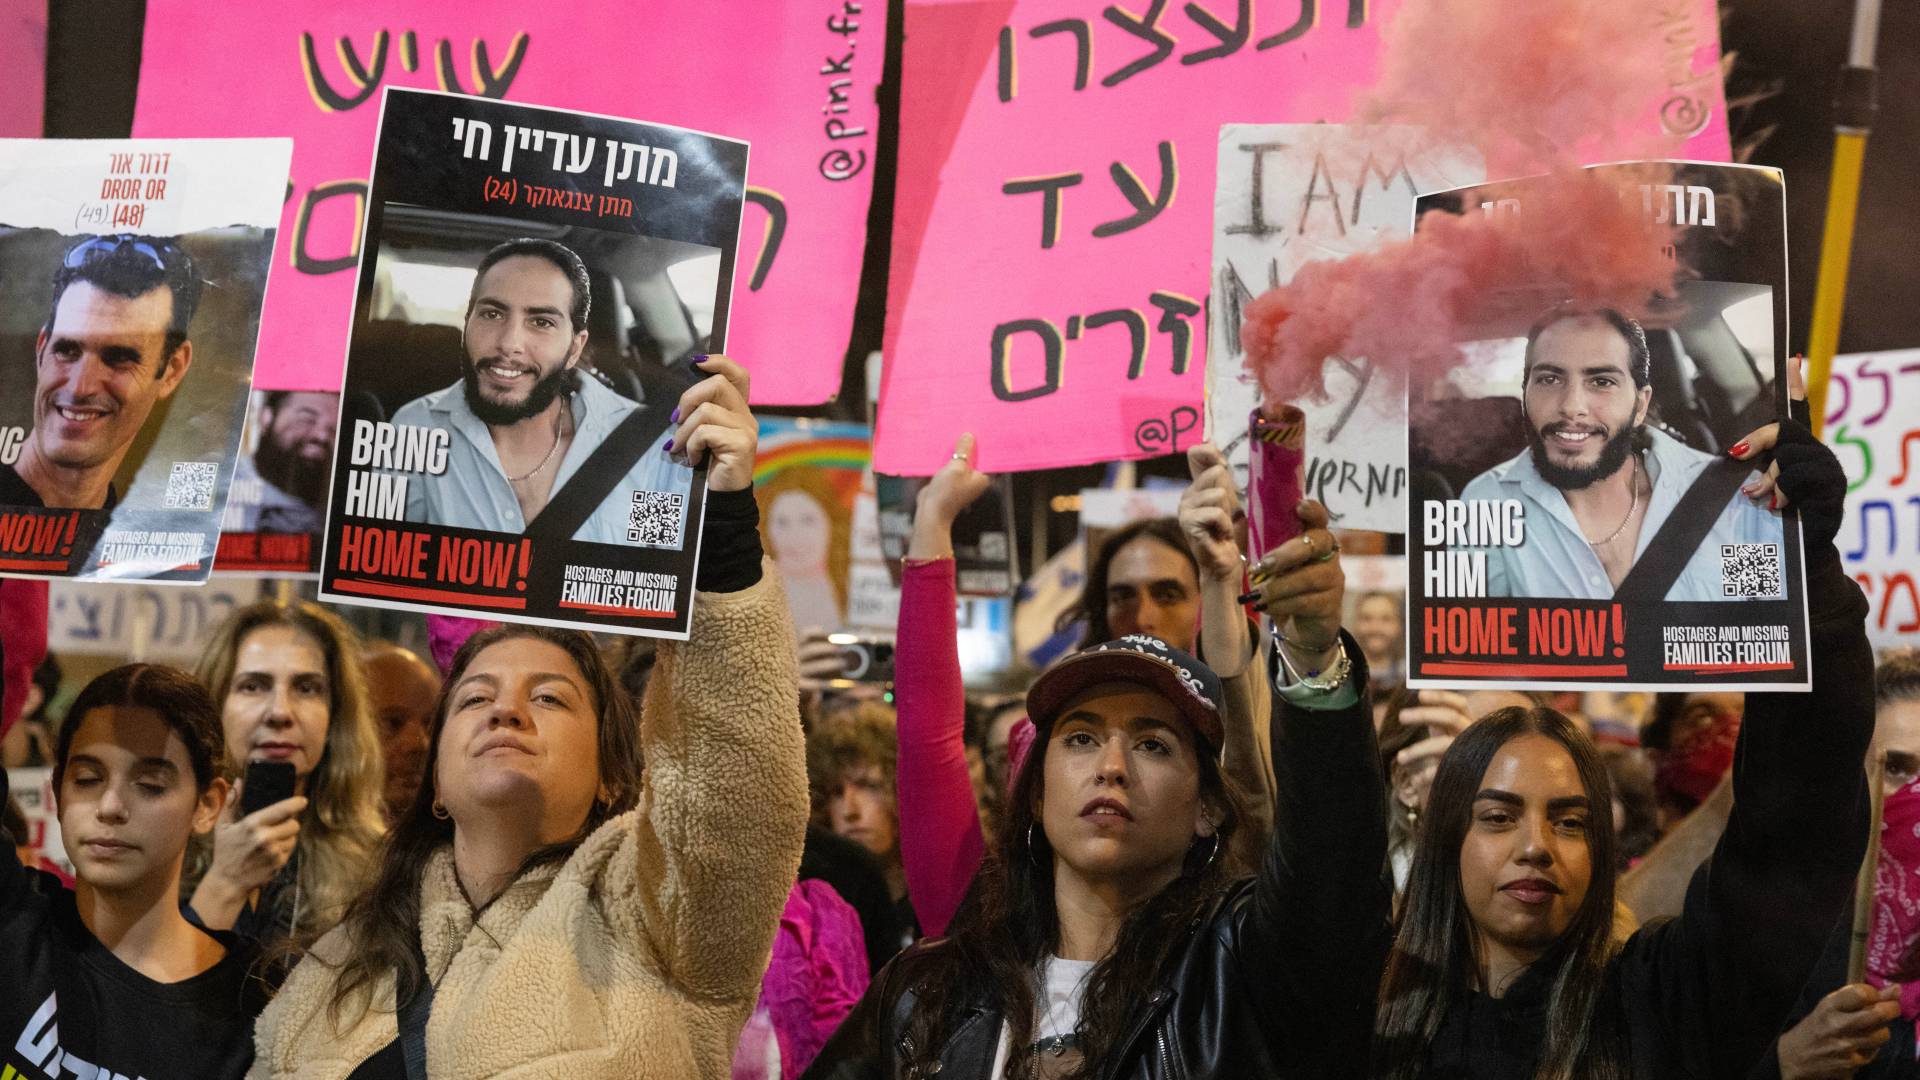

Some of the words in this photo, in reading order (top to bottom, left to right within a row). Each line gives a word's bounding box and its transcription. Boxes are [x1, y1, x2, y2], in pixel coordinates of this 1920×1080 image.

[452, 117, 492, 161] חי
[501, 124, 596, 174] עדיין
[110, 153, 134, 174] אור
[139, 153, 171, 174] דרור
[604, 139, 678, 188] מתן
[101, 178, 142, 201] DROR
[145, 178, 166, 201] OR
[484, 176, 517, 205] (24)
[523, 184, 594, 213] צנגאוקר
[598, 195, 633, 217] מתן
[1002, 141, 1179, 249] עד
[1224, 141, 1291, 237] I
[1297, 151, 1418, 237] AM
[112, 204, 145, 229] (48)
[989, 290, 1210, 402] זרים
[350, 419, 450, 475] BRING
[345, 469, 408, 522] HIM
[0, 511, 81, 556] NOW!
[149, 532, 167, 545] AND
[167, 532, 206, 547] MISSING
[1424, 499, 1526, 547] BRING
[338, 525, 432, 580] HOME
[436, 536, 532, 592] NOW!
[564, 564, 614, 584] HOSTAGES
[614, 569, 635, 586] AND
[634, 571, 678, 591] MISSING
[1424, 550, 1487, 598] HIM
[561, 581, 624, 607] FAMILIES
[625, 586, 676, 613] FORUM
[1424, 606, 1518, 656] HOME
[1528, 603, 1625, 658] NOW!
[1663, 626, 1717, 642] HOSTAGES
[1718, 626, 1740, 642] AND
[1741, 625, 1789, 641] MISSING
[1664, 642, 1733, 665] FAMILIES
[1735, 641, 1791, 664] FORUM
